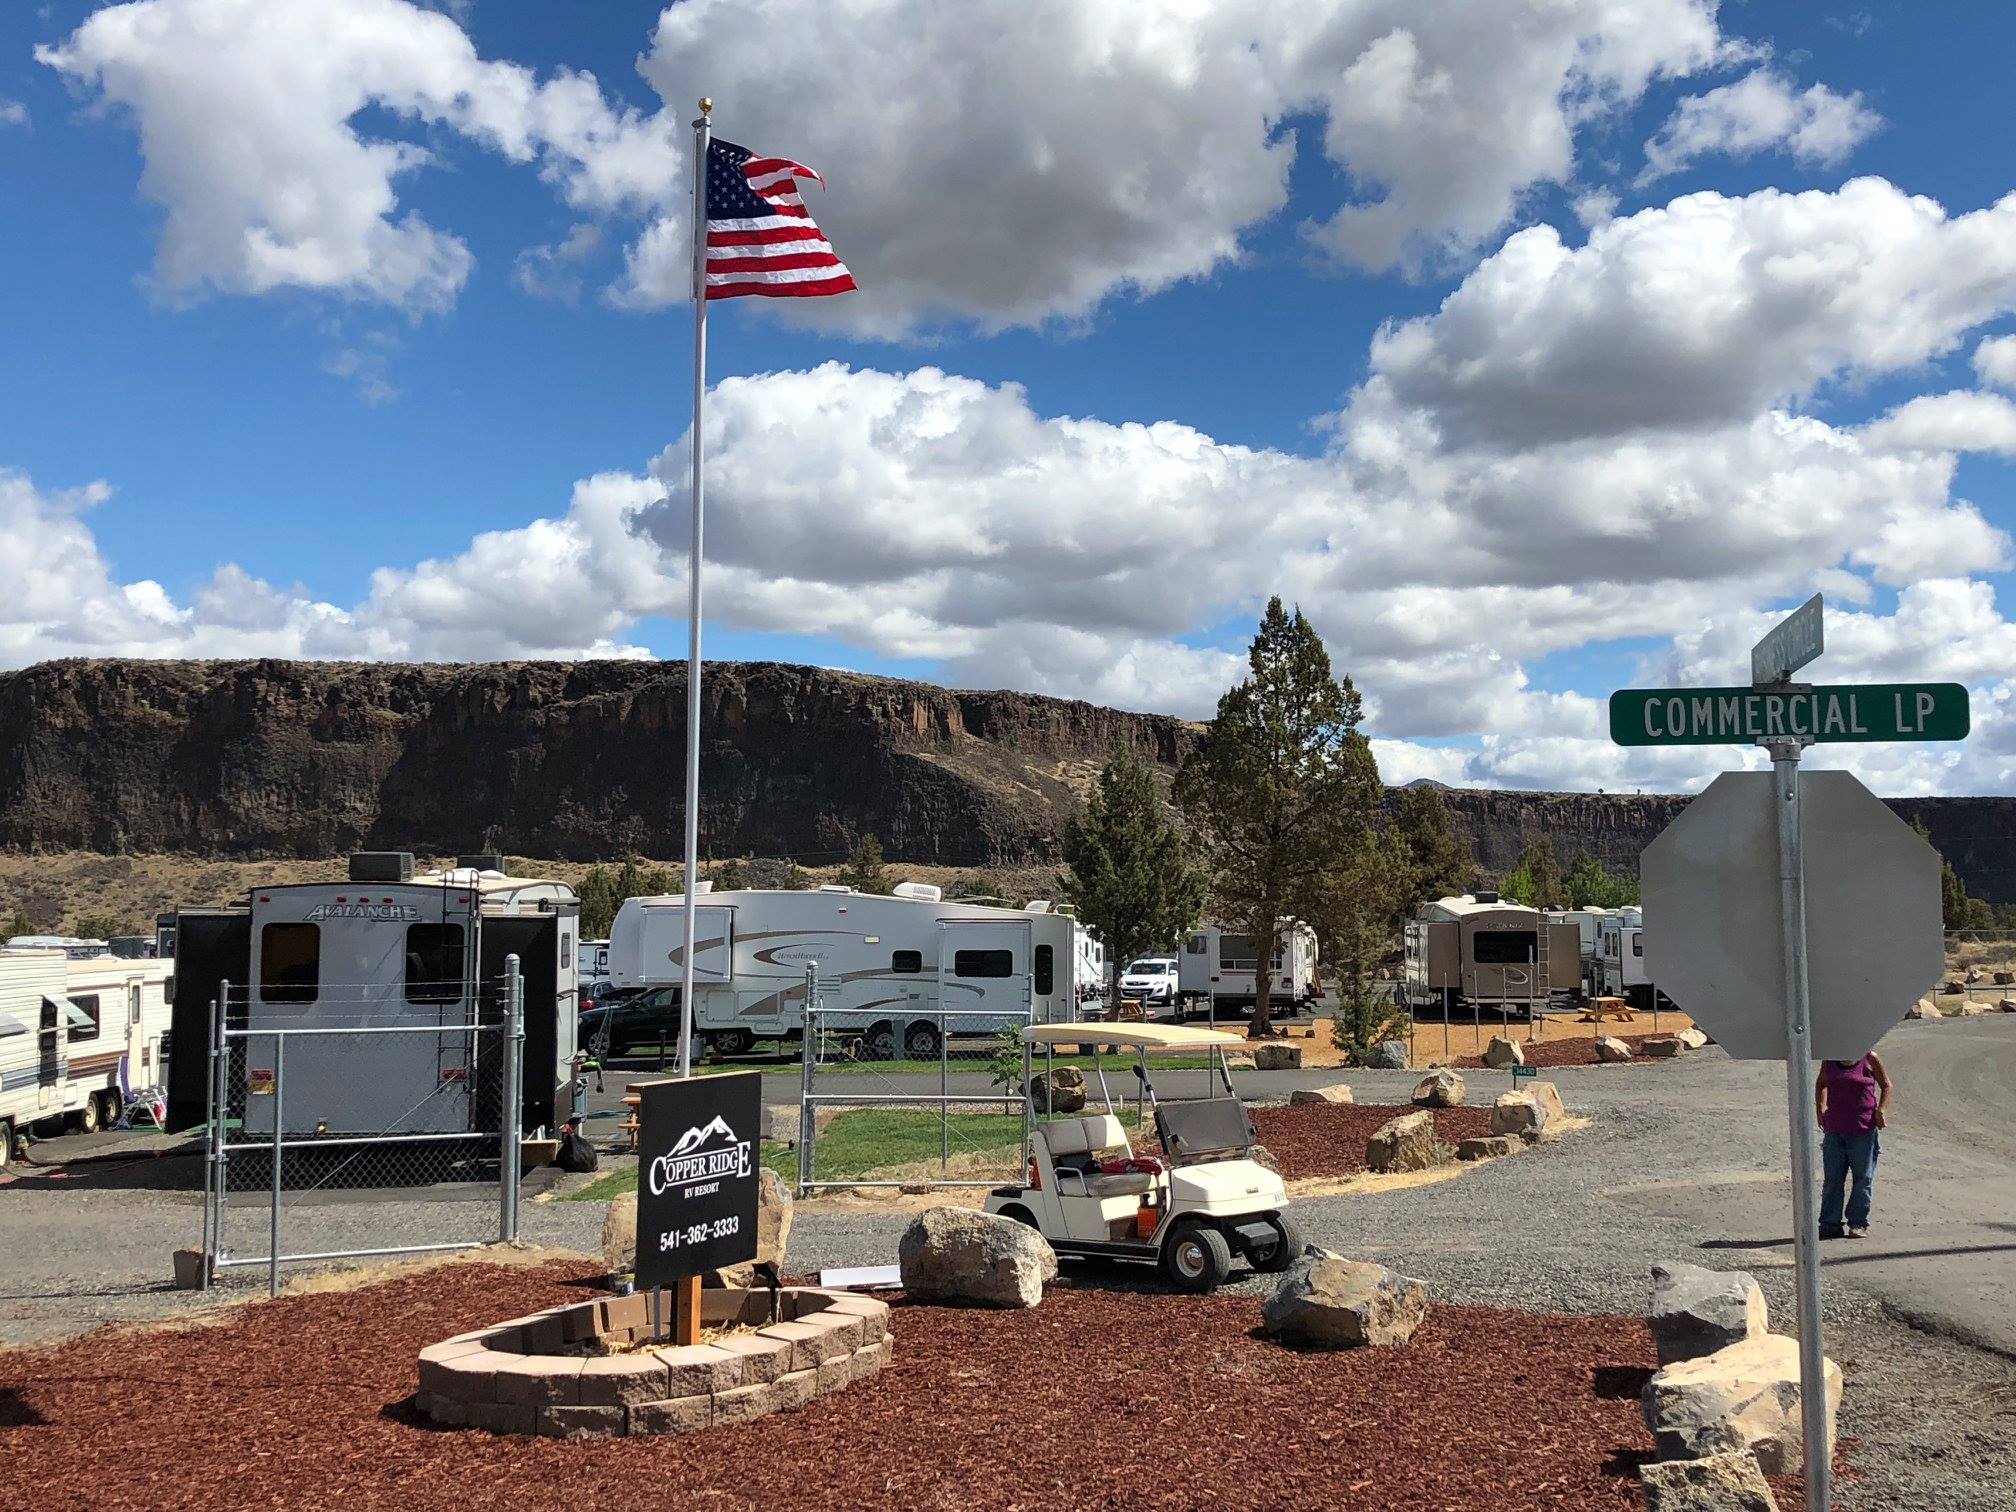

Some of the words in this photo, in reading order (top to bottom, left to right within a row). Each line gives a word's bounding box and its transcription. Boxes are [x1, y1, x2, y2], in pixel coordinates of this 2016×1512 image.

[1644, 694, 1868, 737] COMMERCIAL
[1895, 692, 1935, 733] LP
[303, 904, 422, 922] AVALANCHE
[649, 1156, 706, 1195] COPPER
[709, 1141, 752, 1178] RIDGE
[684, 1188, 695, 1199] RV
[695, 1182, 720, 1197] RESORT
[660, 1216, 739, 1252] 541-362-3333
